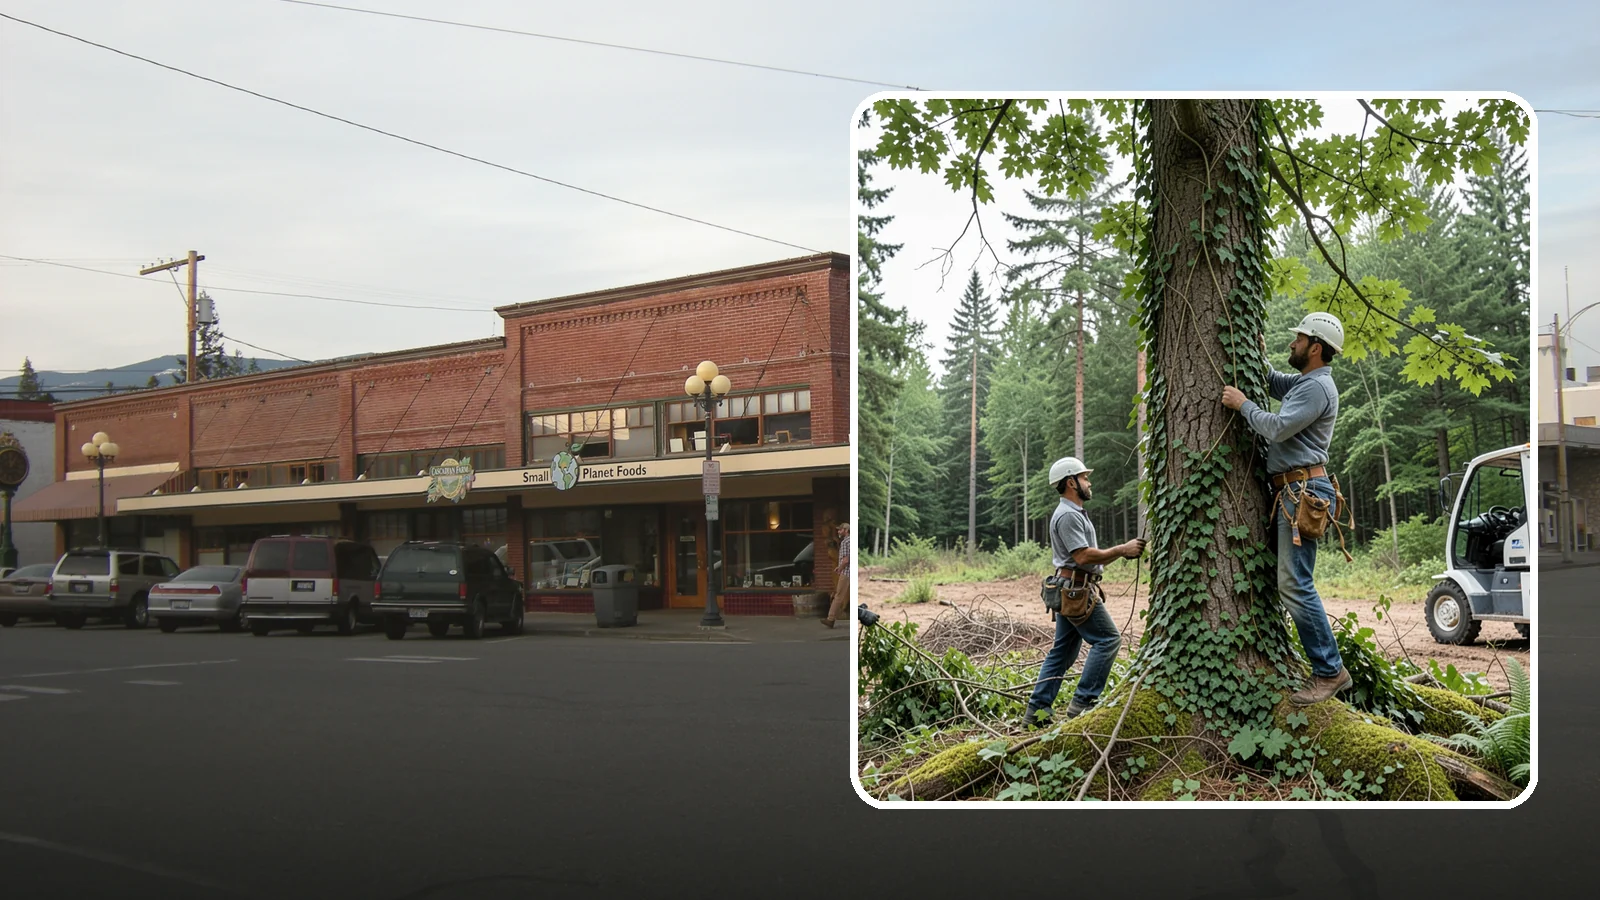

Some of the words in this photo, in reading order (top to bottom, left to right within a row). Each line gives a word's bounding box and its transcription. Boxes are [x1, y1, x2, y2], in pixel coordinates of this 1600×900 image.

[431, 466, 455, 475] CASCADIAN
[523, 471, 549, 483] Small
[583, 468, 614, 479] Planet
[617, 464, 647, 477] Foods
